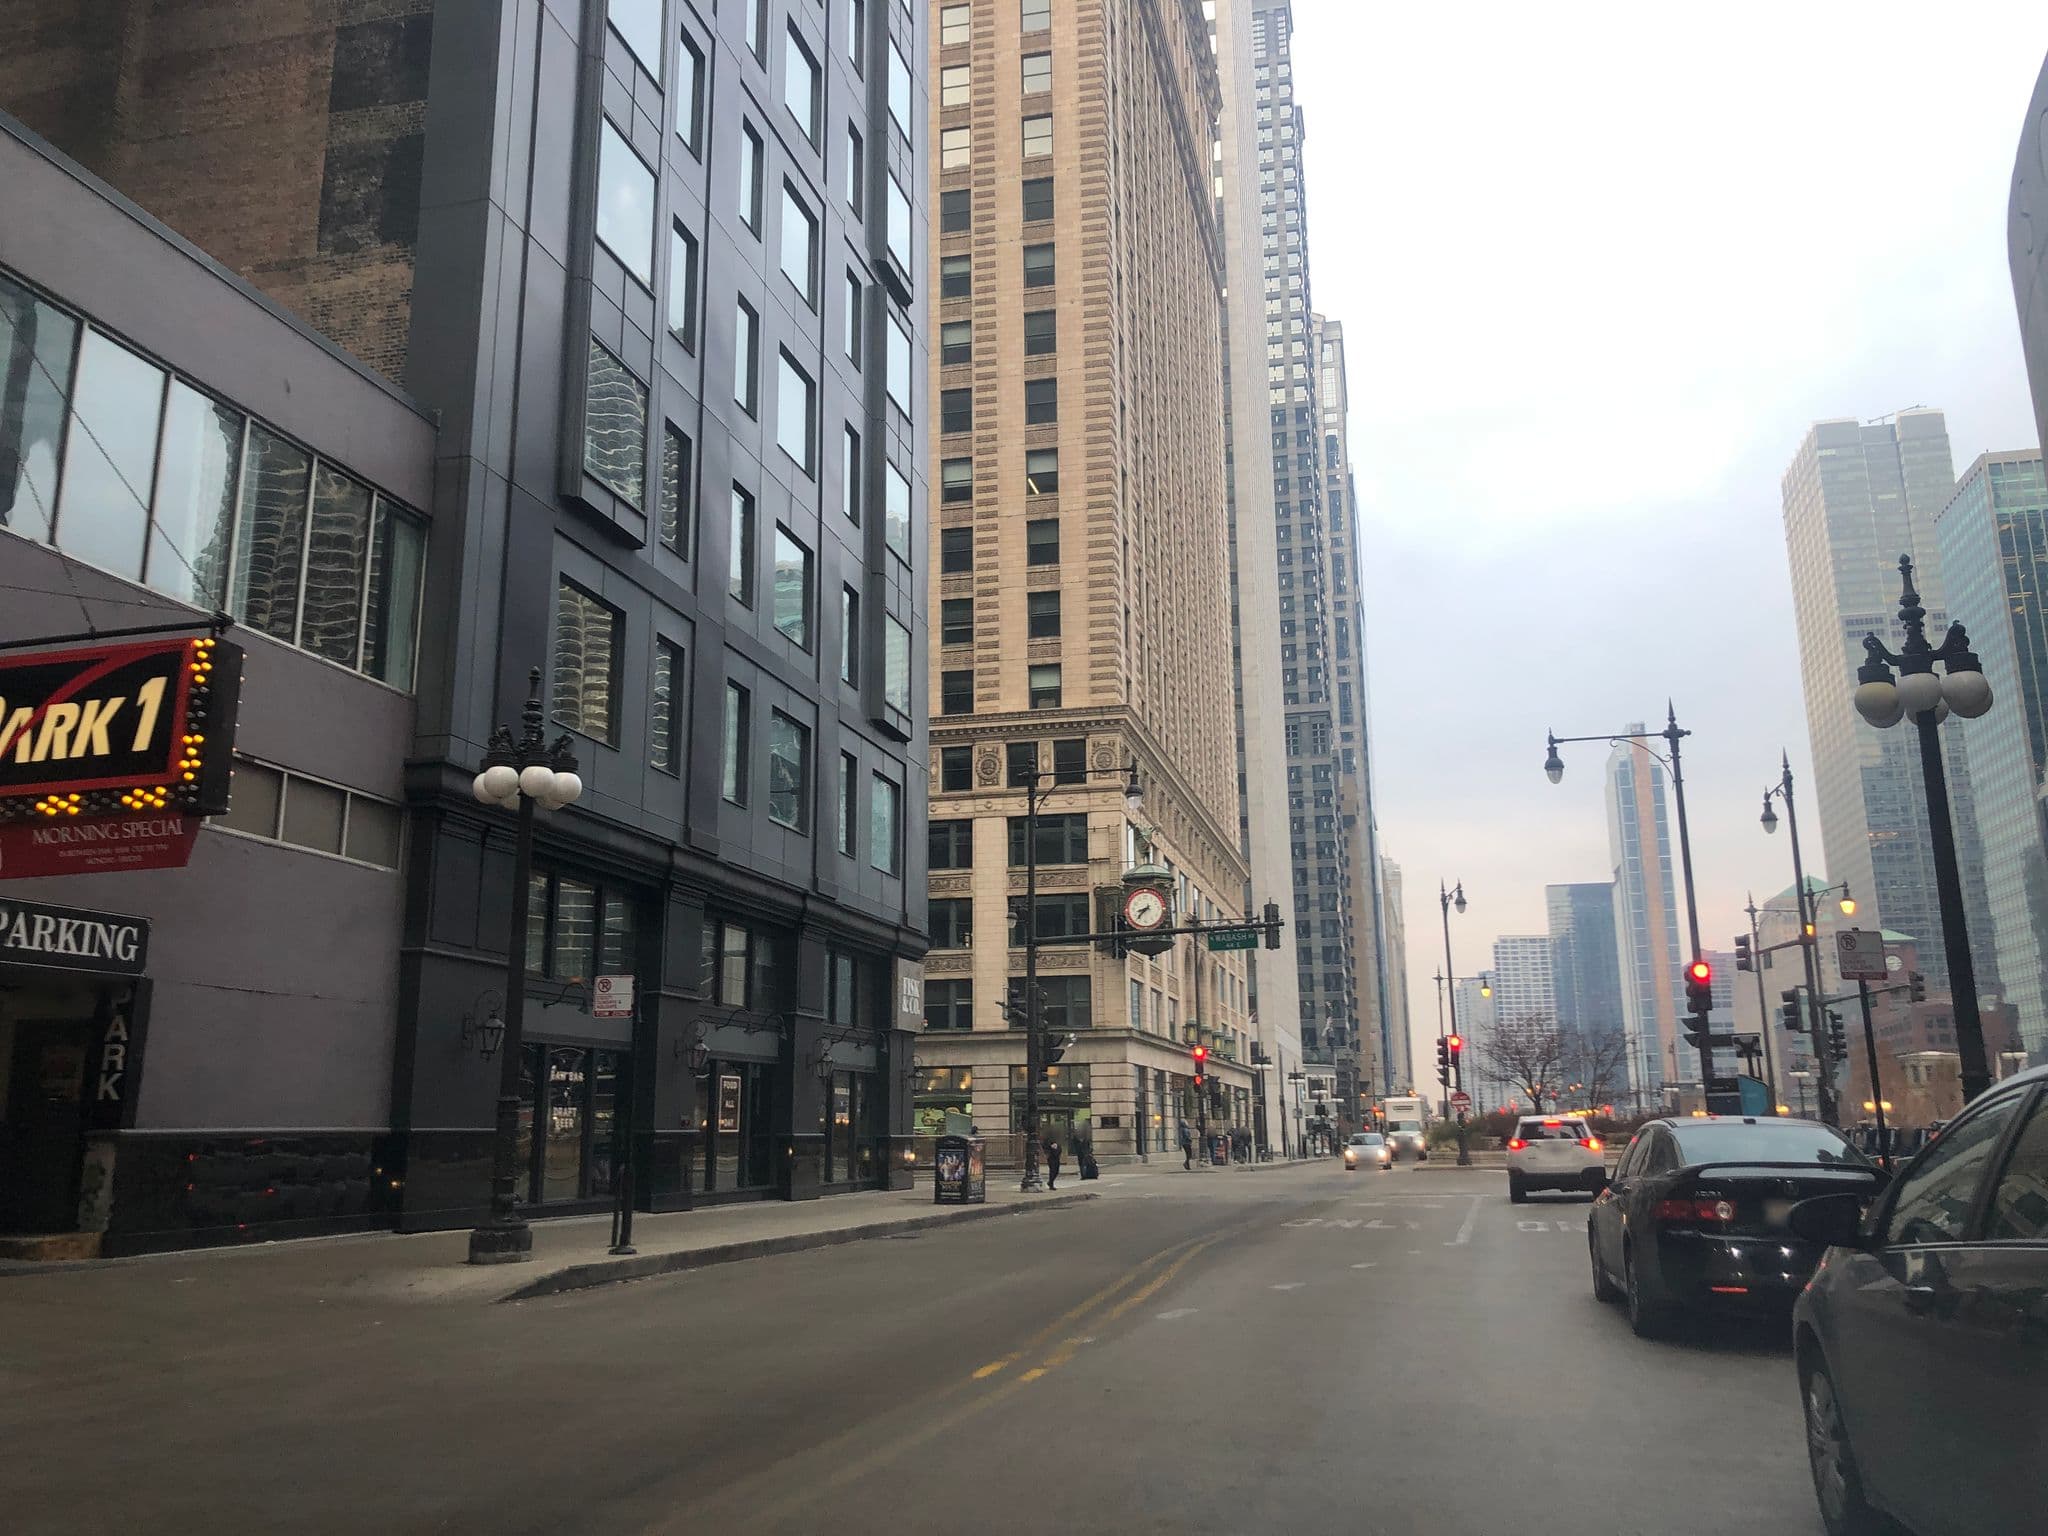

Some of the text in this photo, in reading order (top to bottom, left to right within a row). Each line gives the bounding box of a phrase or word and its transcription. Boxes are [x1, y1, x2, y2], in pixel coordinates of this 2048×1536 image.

[0, 676, 168, 764] ARK 1
[32, 818, 185, 845] MORNING SPECIAL
[1215, 933, 1247, 941] WABASH
[554, 1118, 575, 1130] BEER
